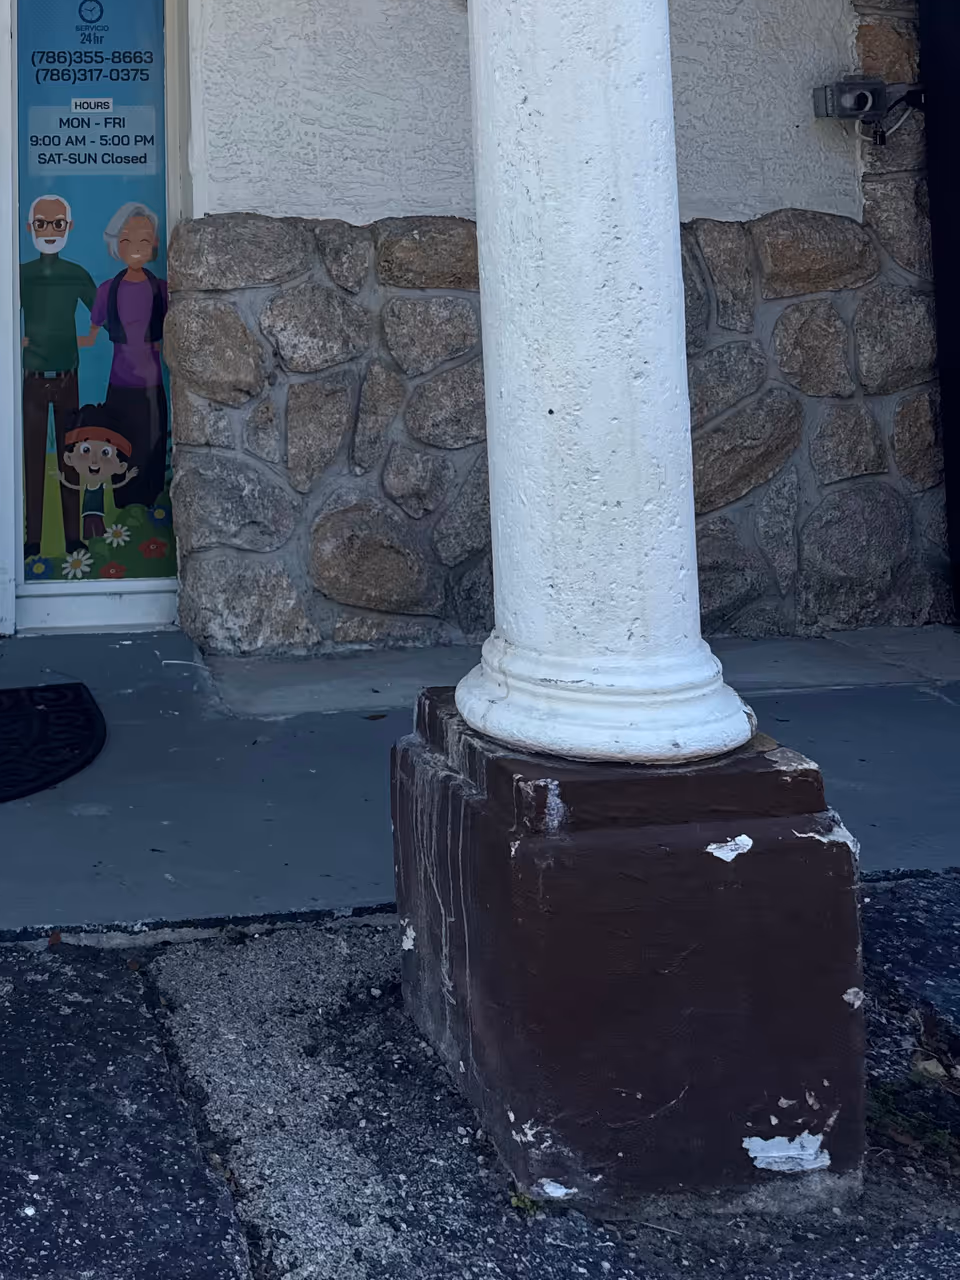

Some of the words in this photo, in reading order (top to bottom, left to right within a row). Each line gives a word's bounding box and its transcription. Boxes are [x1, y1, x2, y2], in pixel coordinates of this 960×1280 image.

[31, 51, 154, 67] (786)355-8663
[35, 68, 149, 84] (786)317-0375
[74, 101, 110, 110] HOURS
[59, 117, 91, 128] MON
[104, 117, 125, 128] FRI
[30, 135, 61, 146] 9:00
[65, 135, 86, 146] AM
[99, 135, 130, 146] 5:00
[134, 135, 154, 146] PM
[37, 153, 97, 164] SAT-SUN
[101, 153, 147, 164] Closed
